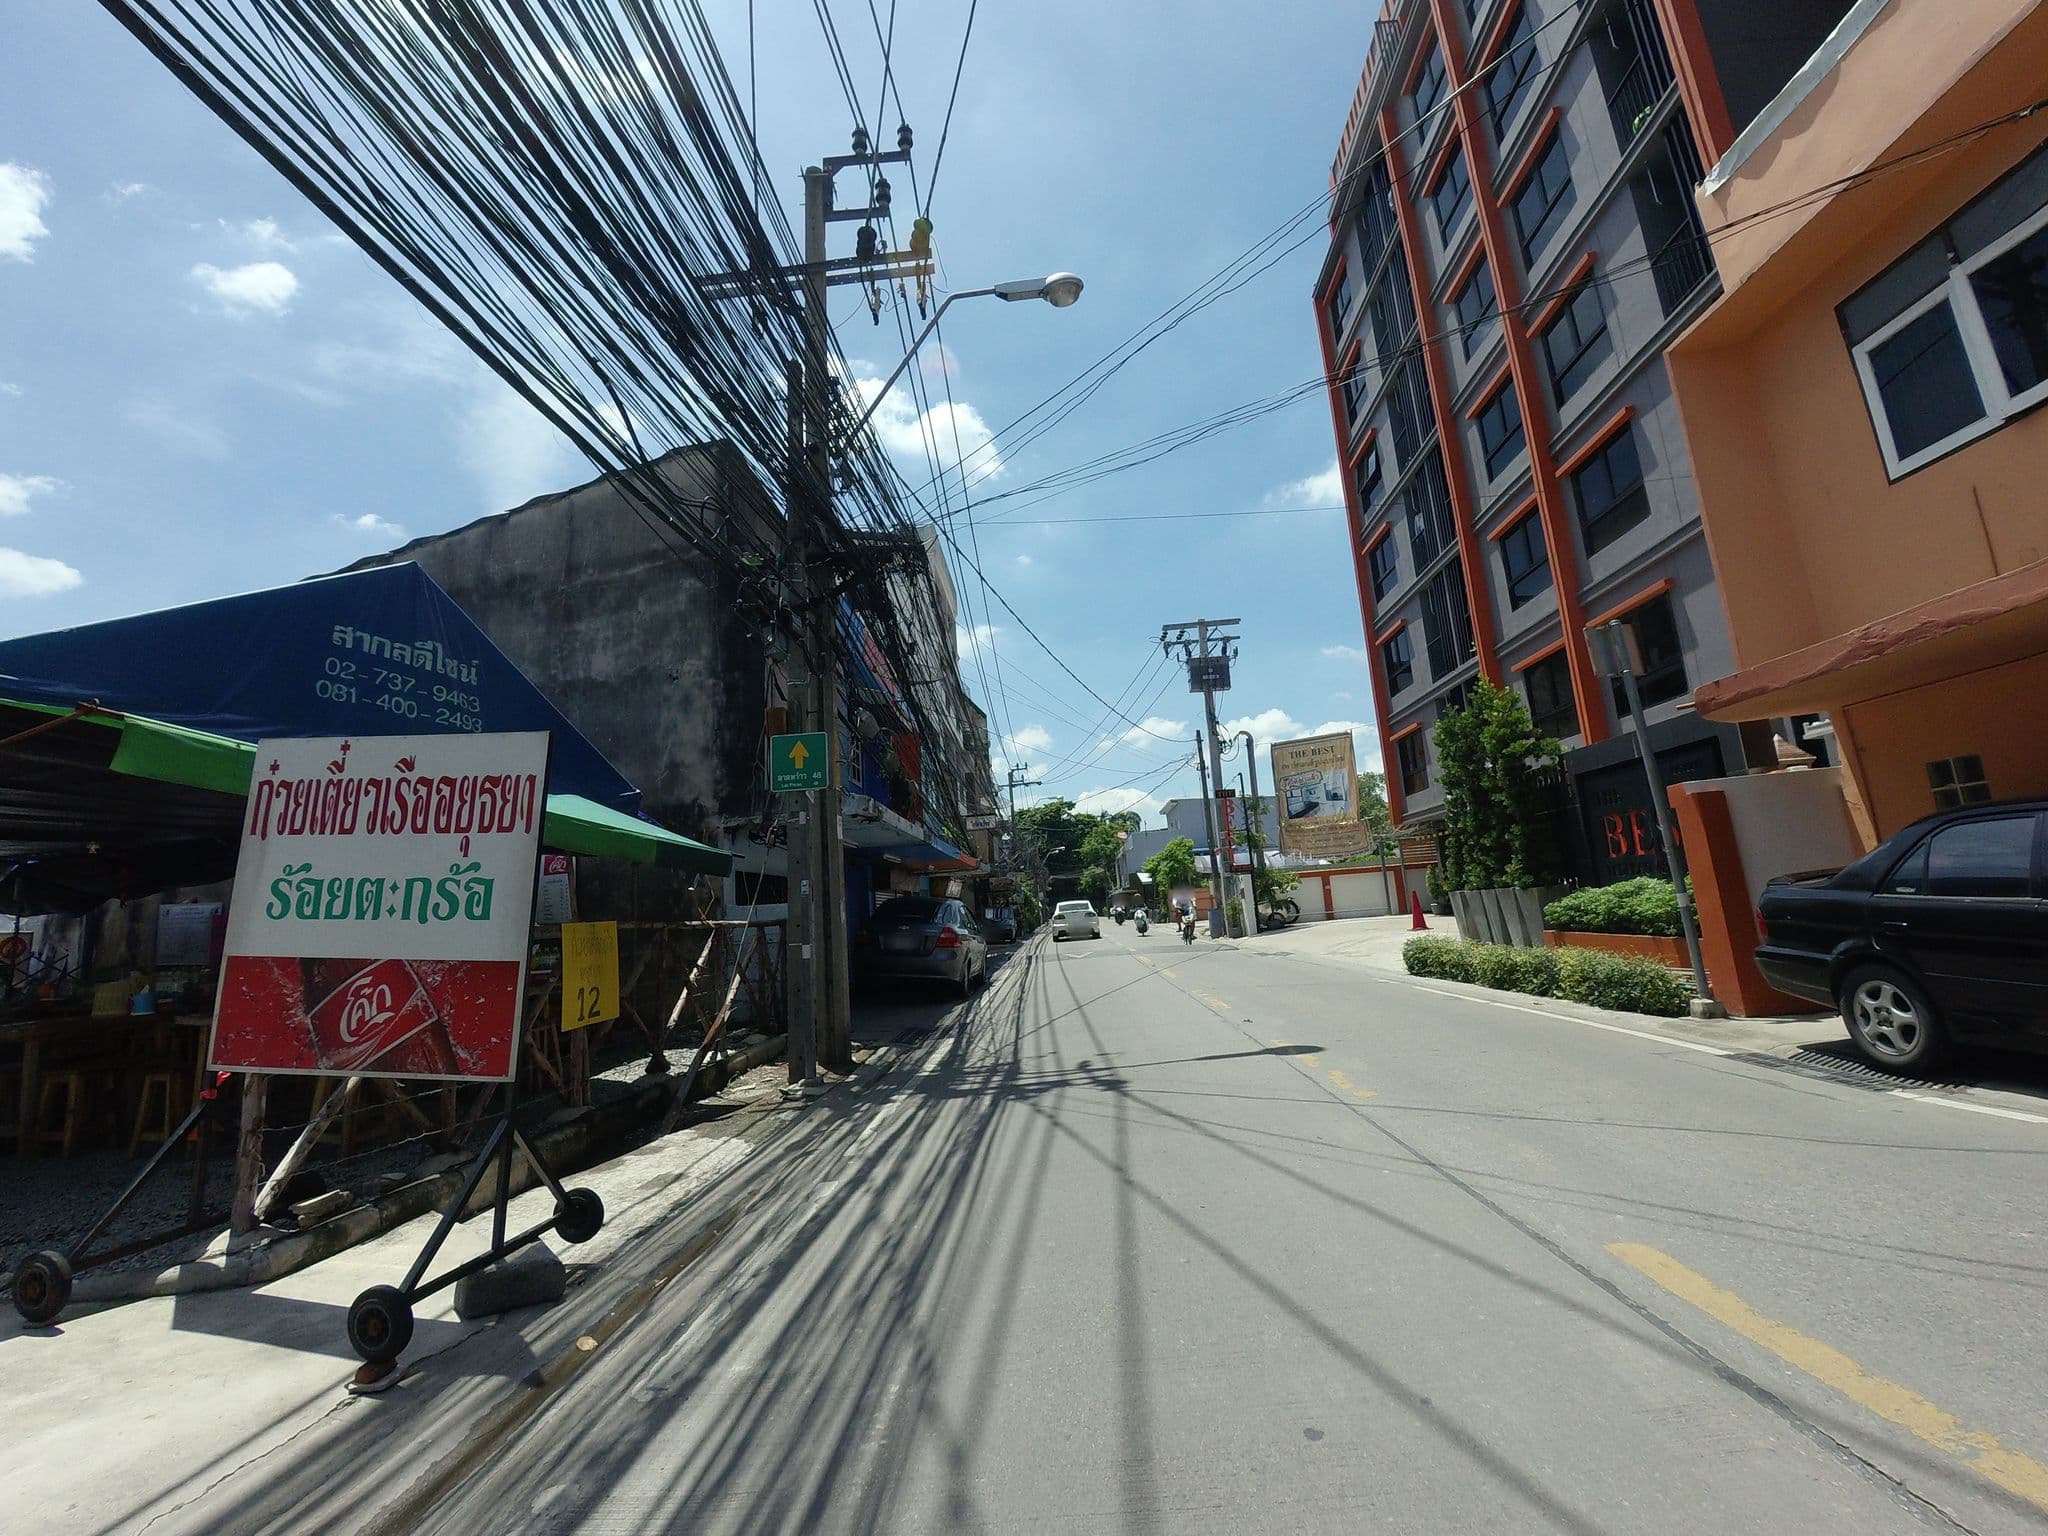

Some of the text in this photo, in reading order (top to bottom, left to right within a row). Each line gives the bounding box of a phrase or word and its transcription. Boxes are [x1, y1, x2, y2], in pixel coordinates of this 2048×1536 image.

[1289, 745, 1336, 760] THE BEST
[250, 739, 538, 857] ก๋วยเตี๋ยวเรืออยุธยา
[1602, 808, 1681, 859] BE
[266, 862, 496, 926] ร้อยตะกร้อ
[577, 986, 601, 1022] 12
